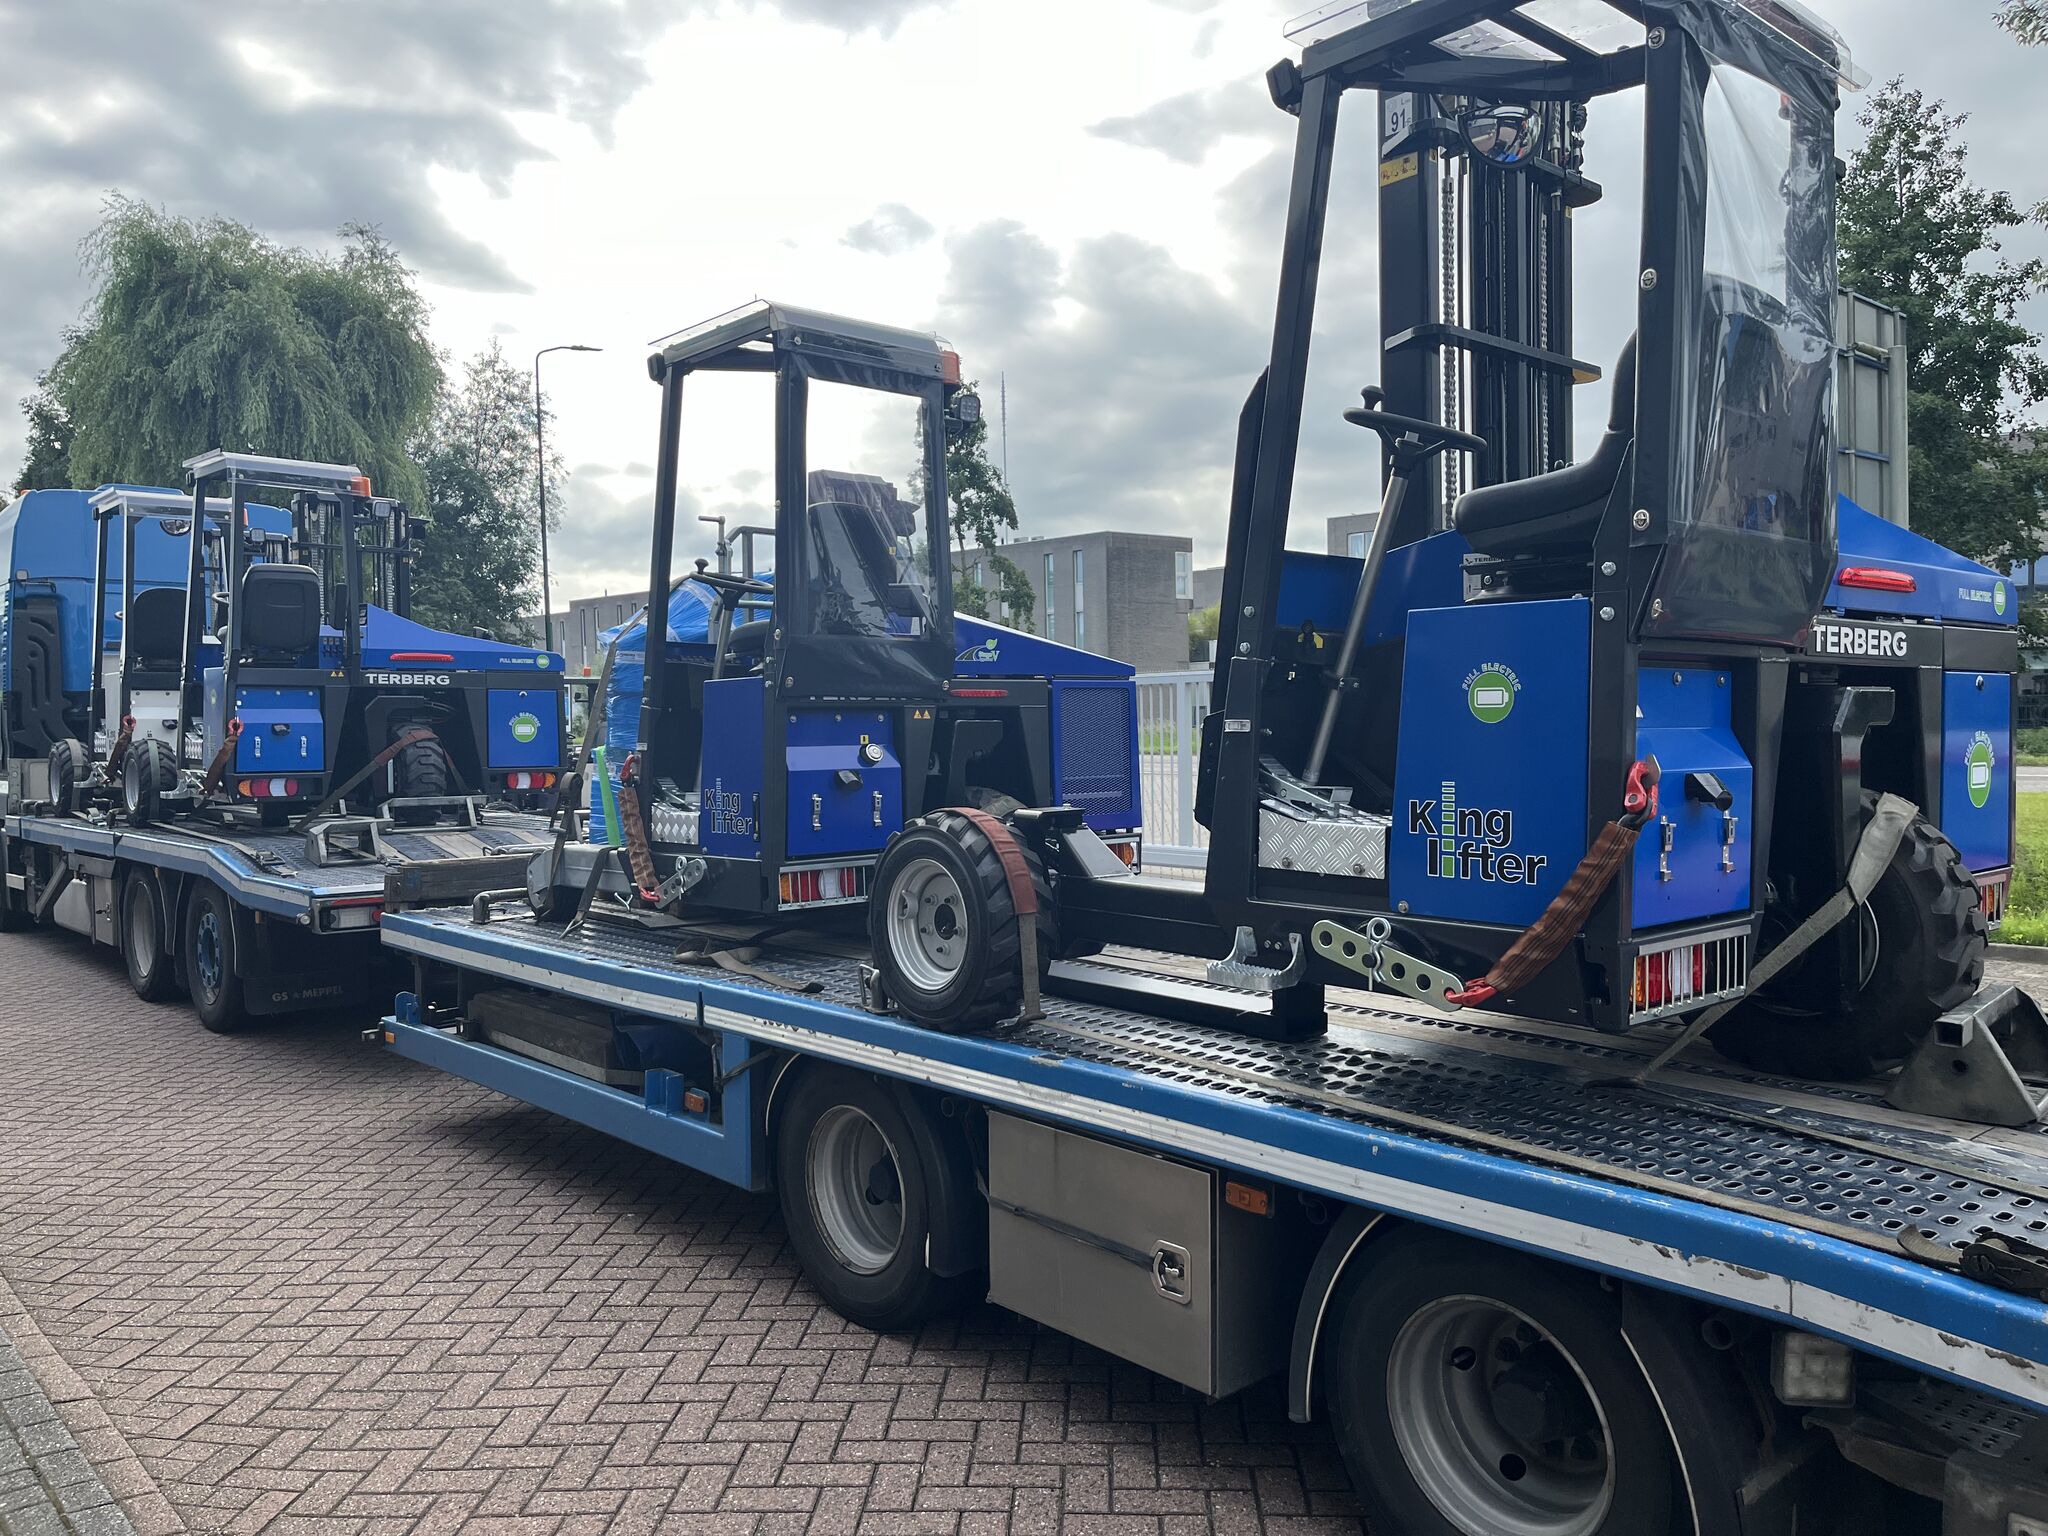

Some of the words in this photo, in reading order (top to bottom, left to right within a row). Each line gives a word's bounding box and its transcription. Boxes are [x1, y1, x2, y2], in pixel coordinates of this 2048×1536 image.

[1391, 108, 1406, 133] 91
[1958, 587, 1970, 600] FULL
[1812, 624, 1908, 657] TERBERG
[365, 673, 450, 686] TERBERG
[1461, 668, 1480, 691] FULL
[1481, 662, 1522, 692] ELECTRIC
[704, 778, 741, 816] King
[1408, 781, 1513, 848] King
[272, 992, 289, 1002] GS
